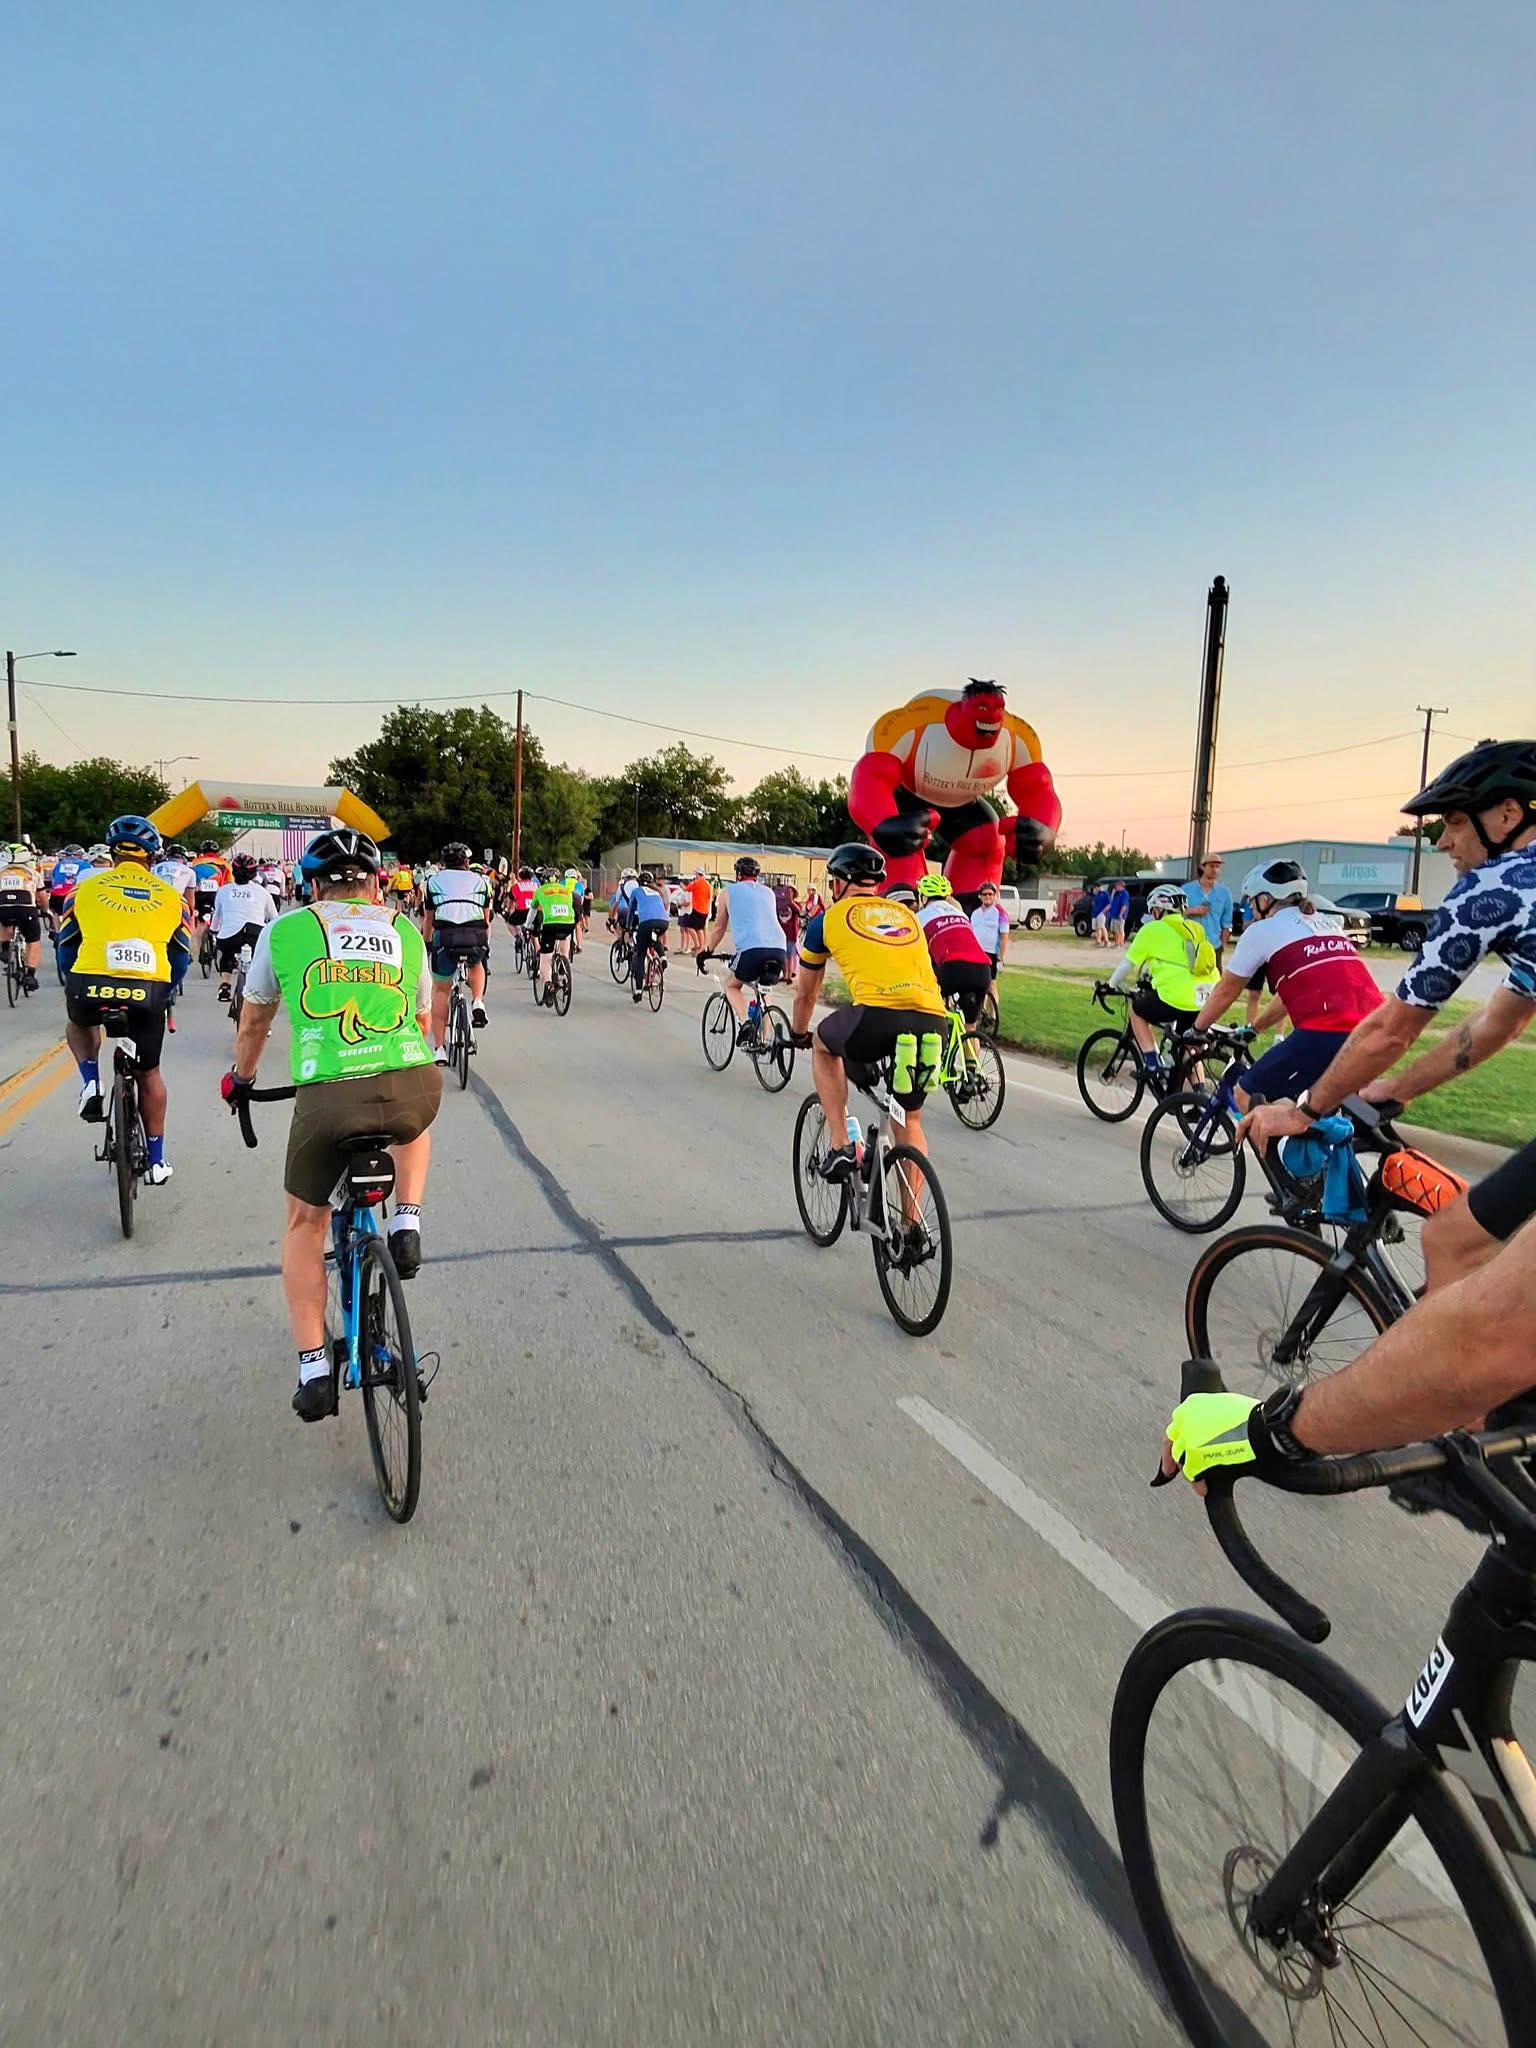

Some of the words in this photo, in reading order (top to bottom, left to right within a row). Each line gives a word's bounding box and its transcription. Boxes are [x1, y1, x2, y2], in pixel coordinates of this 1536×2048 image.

[278, 801, 294, 812] HELL
[295, 802, 327, 813] HUNDRED
[234, 817, 256, 828] First
[257, 818, 281, 828] Bank
[1341, 864, 1378, 881] Airgas
[340, 934, 394, 955] 2290
[1303, 941, 1327, 958] Red
[114, 949, 150, 965] 3850
[86, 985, 147, 1001] 1899
